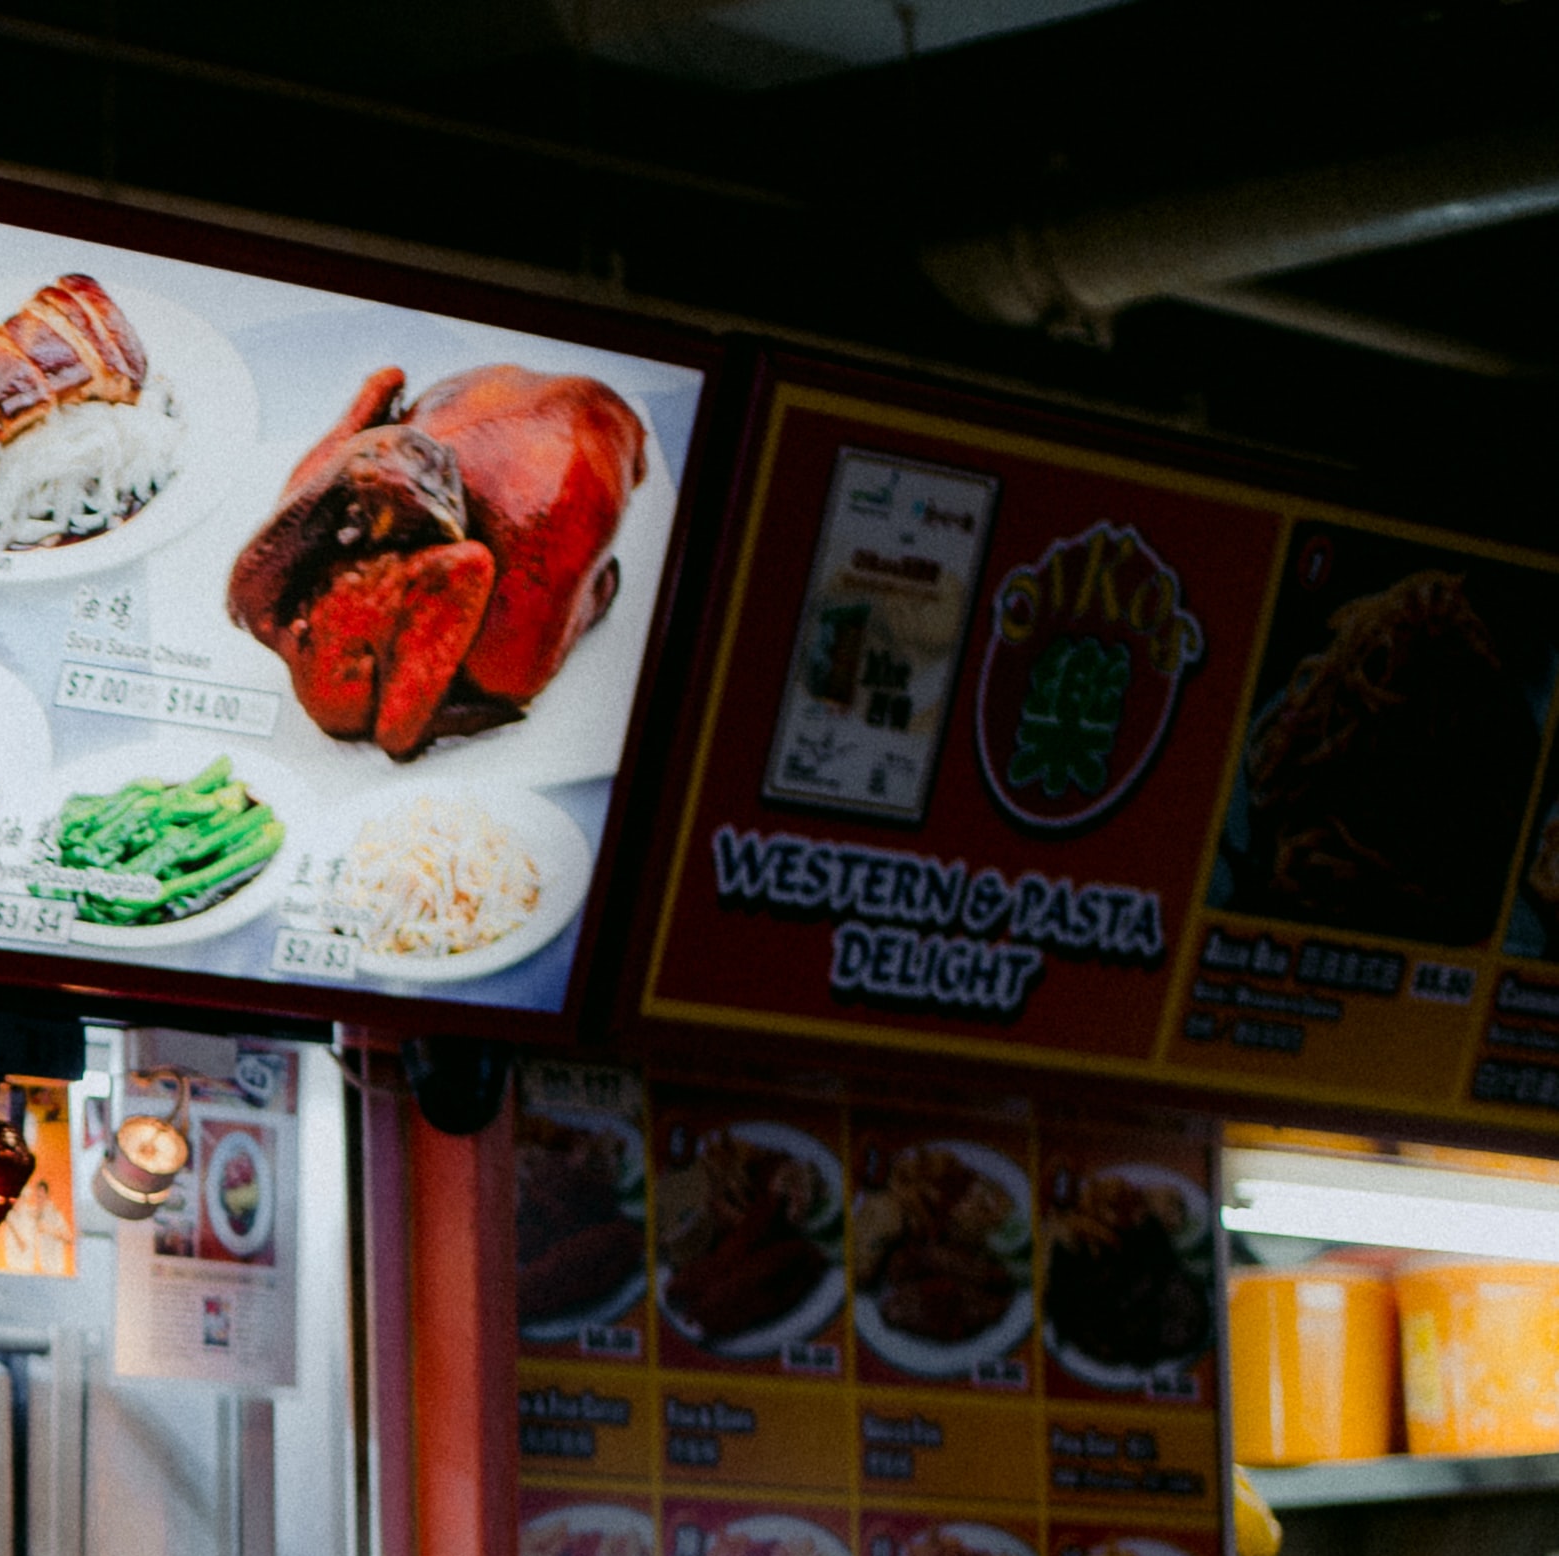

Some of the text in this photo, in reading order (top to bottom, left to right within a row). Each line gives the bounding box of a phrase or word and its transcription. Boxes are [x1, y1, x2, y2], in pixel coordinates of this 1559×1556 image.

[713, 825, 1162, 957] WESTERN & PASTA
[831, 920, 1042, 1011] DELIGHT
